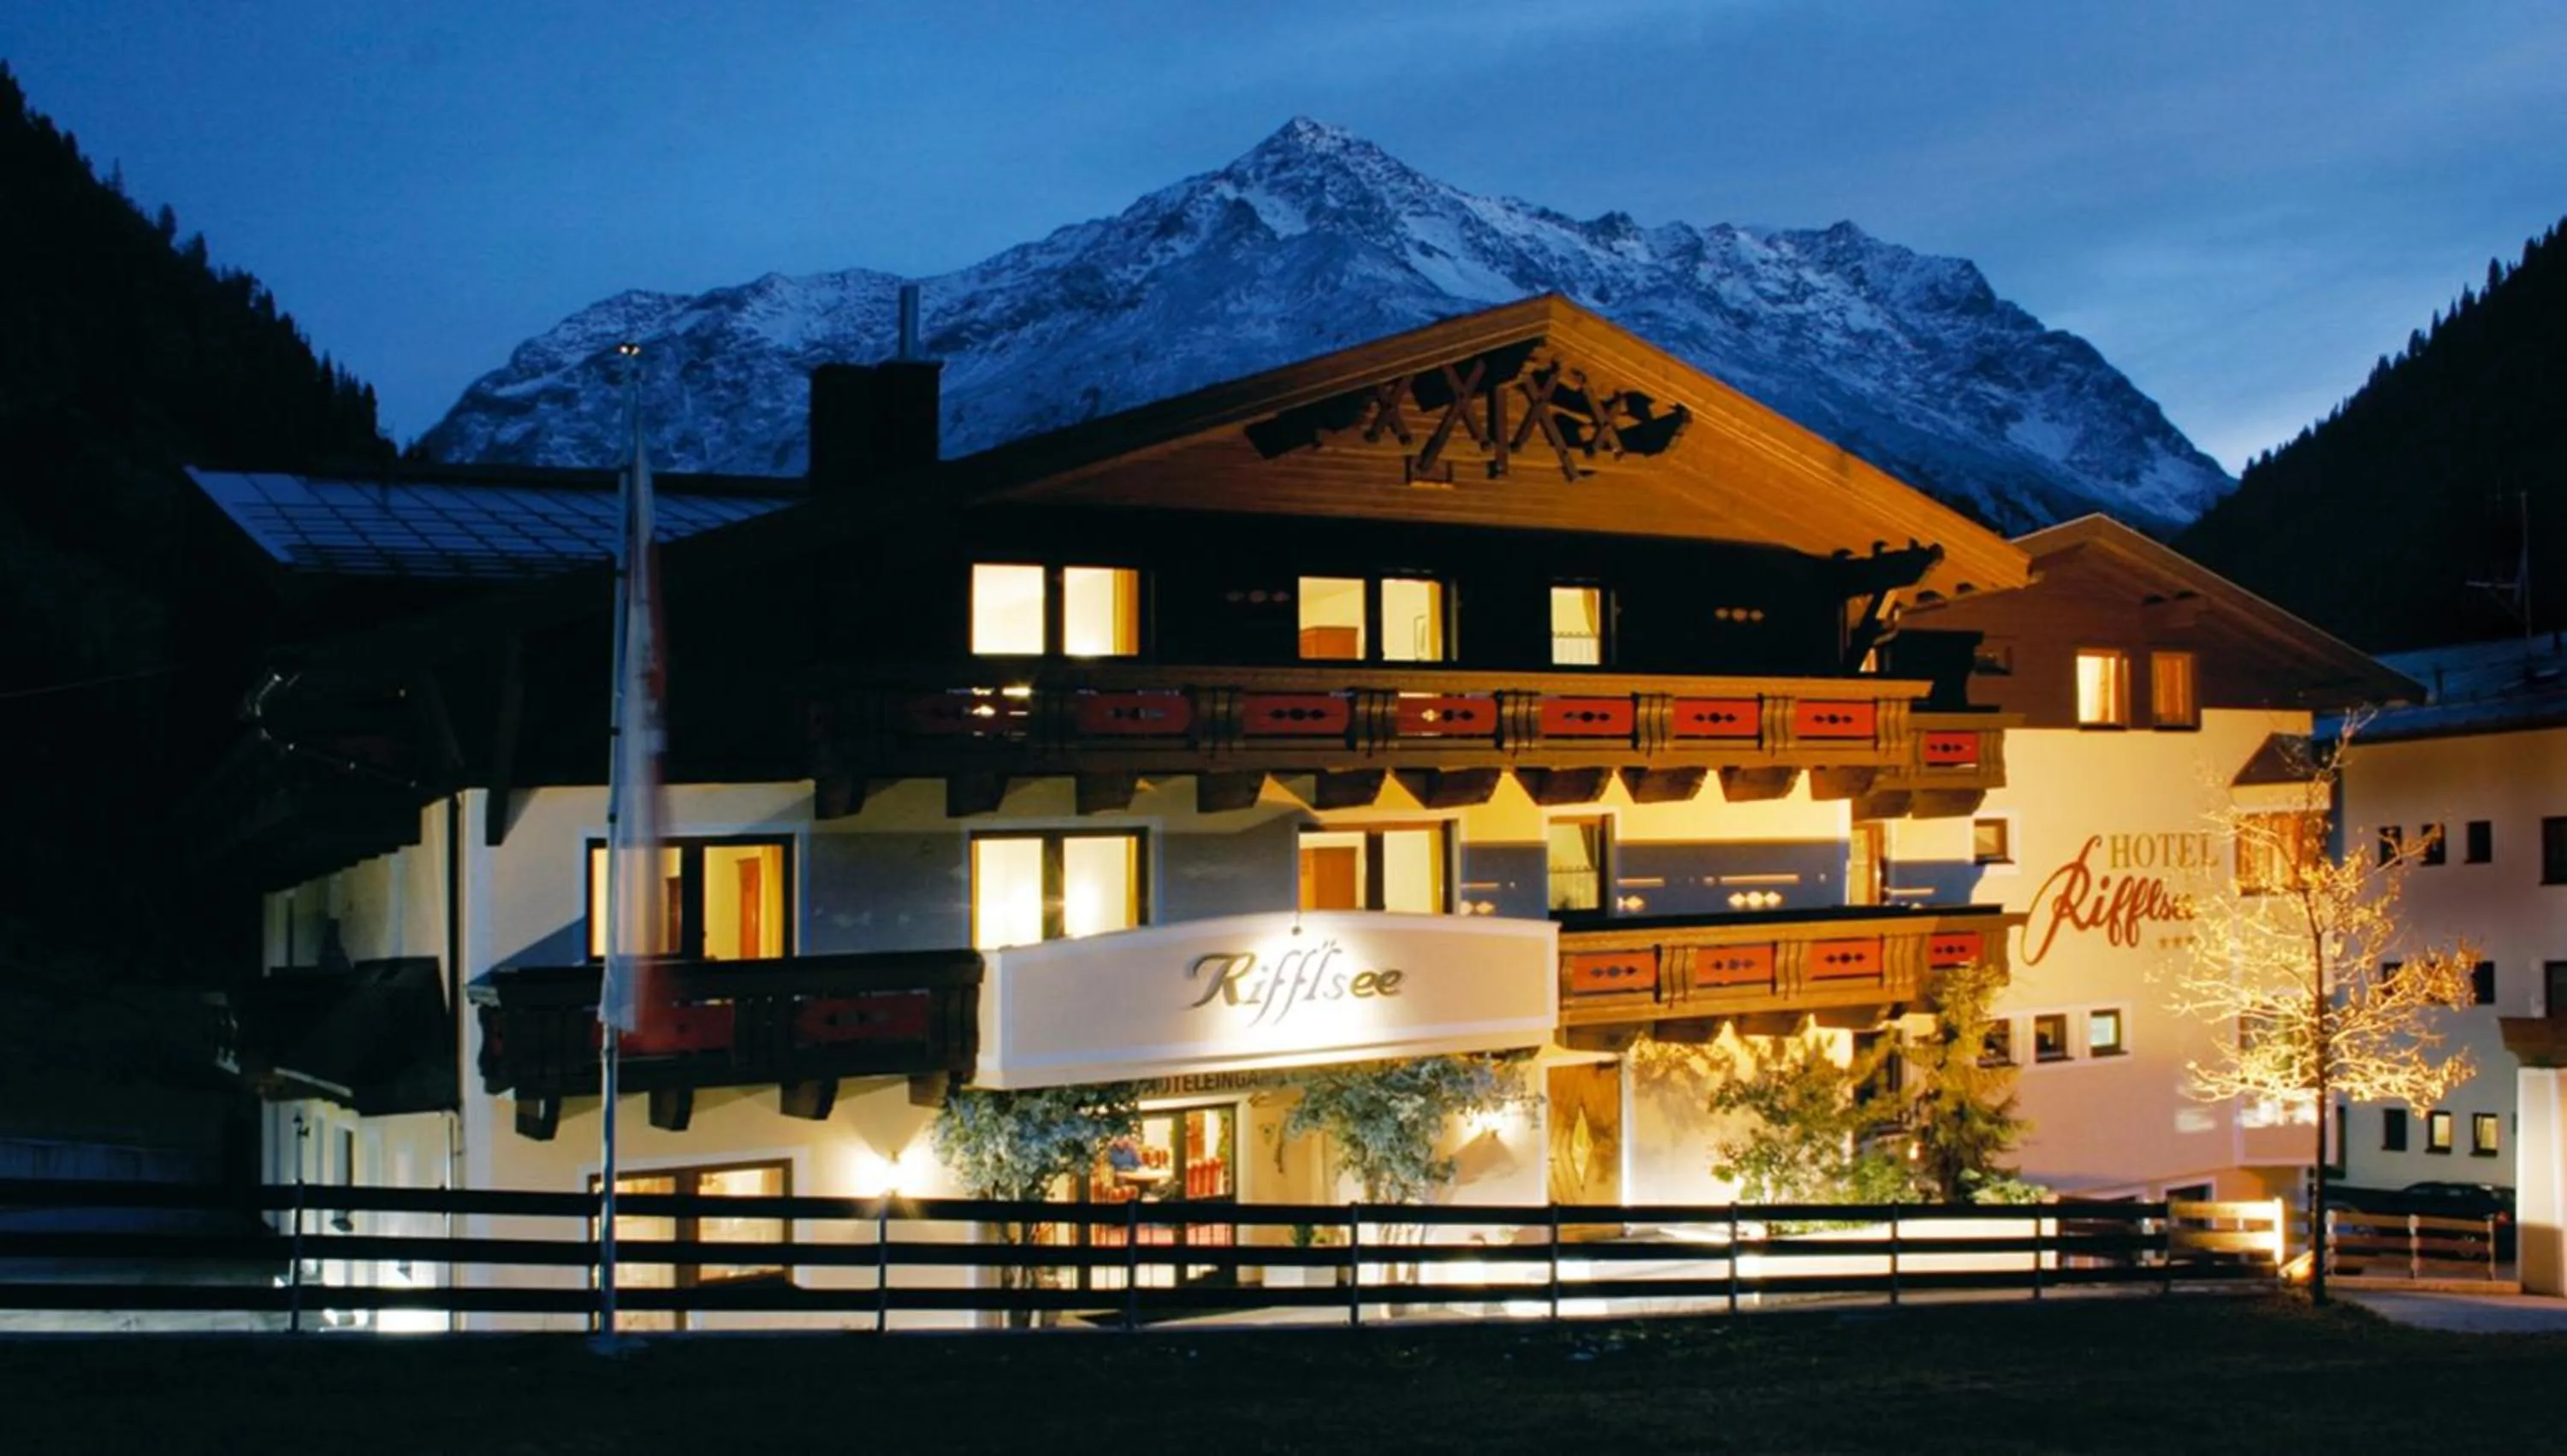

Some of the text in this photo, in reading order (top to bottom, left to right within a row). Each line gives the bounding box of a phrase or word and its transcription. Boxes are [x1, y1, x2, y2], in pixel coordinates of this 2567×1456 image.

[2109, 832, 2219, 869] HOTEL
[2020, 834, 2196, 966] Rifflsee
[1180, 941, 1404, 1027] Rifflsee
